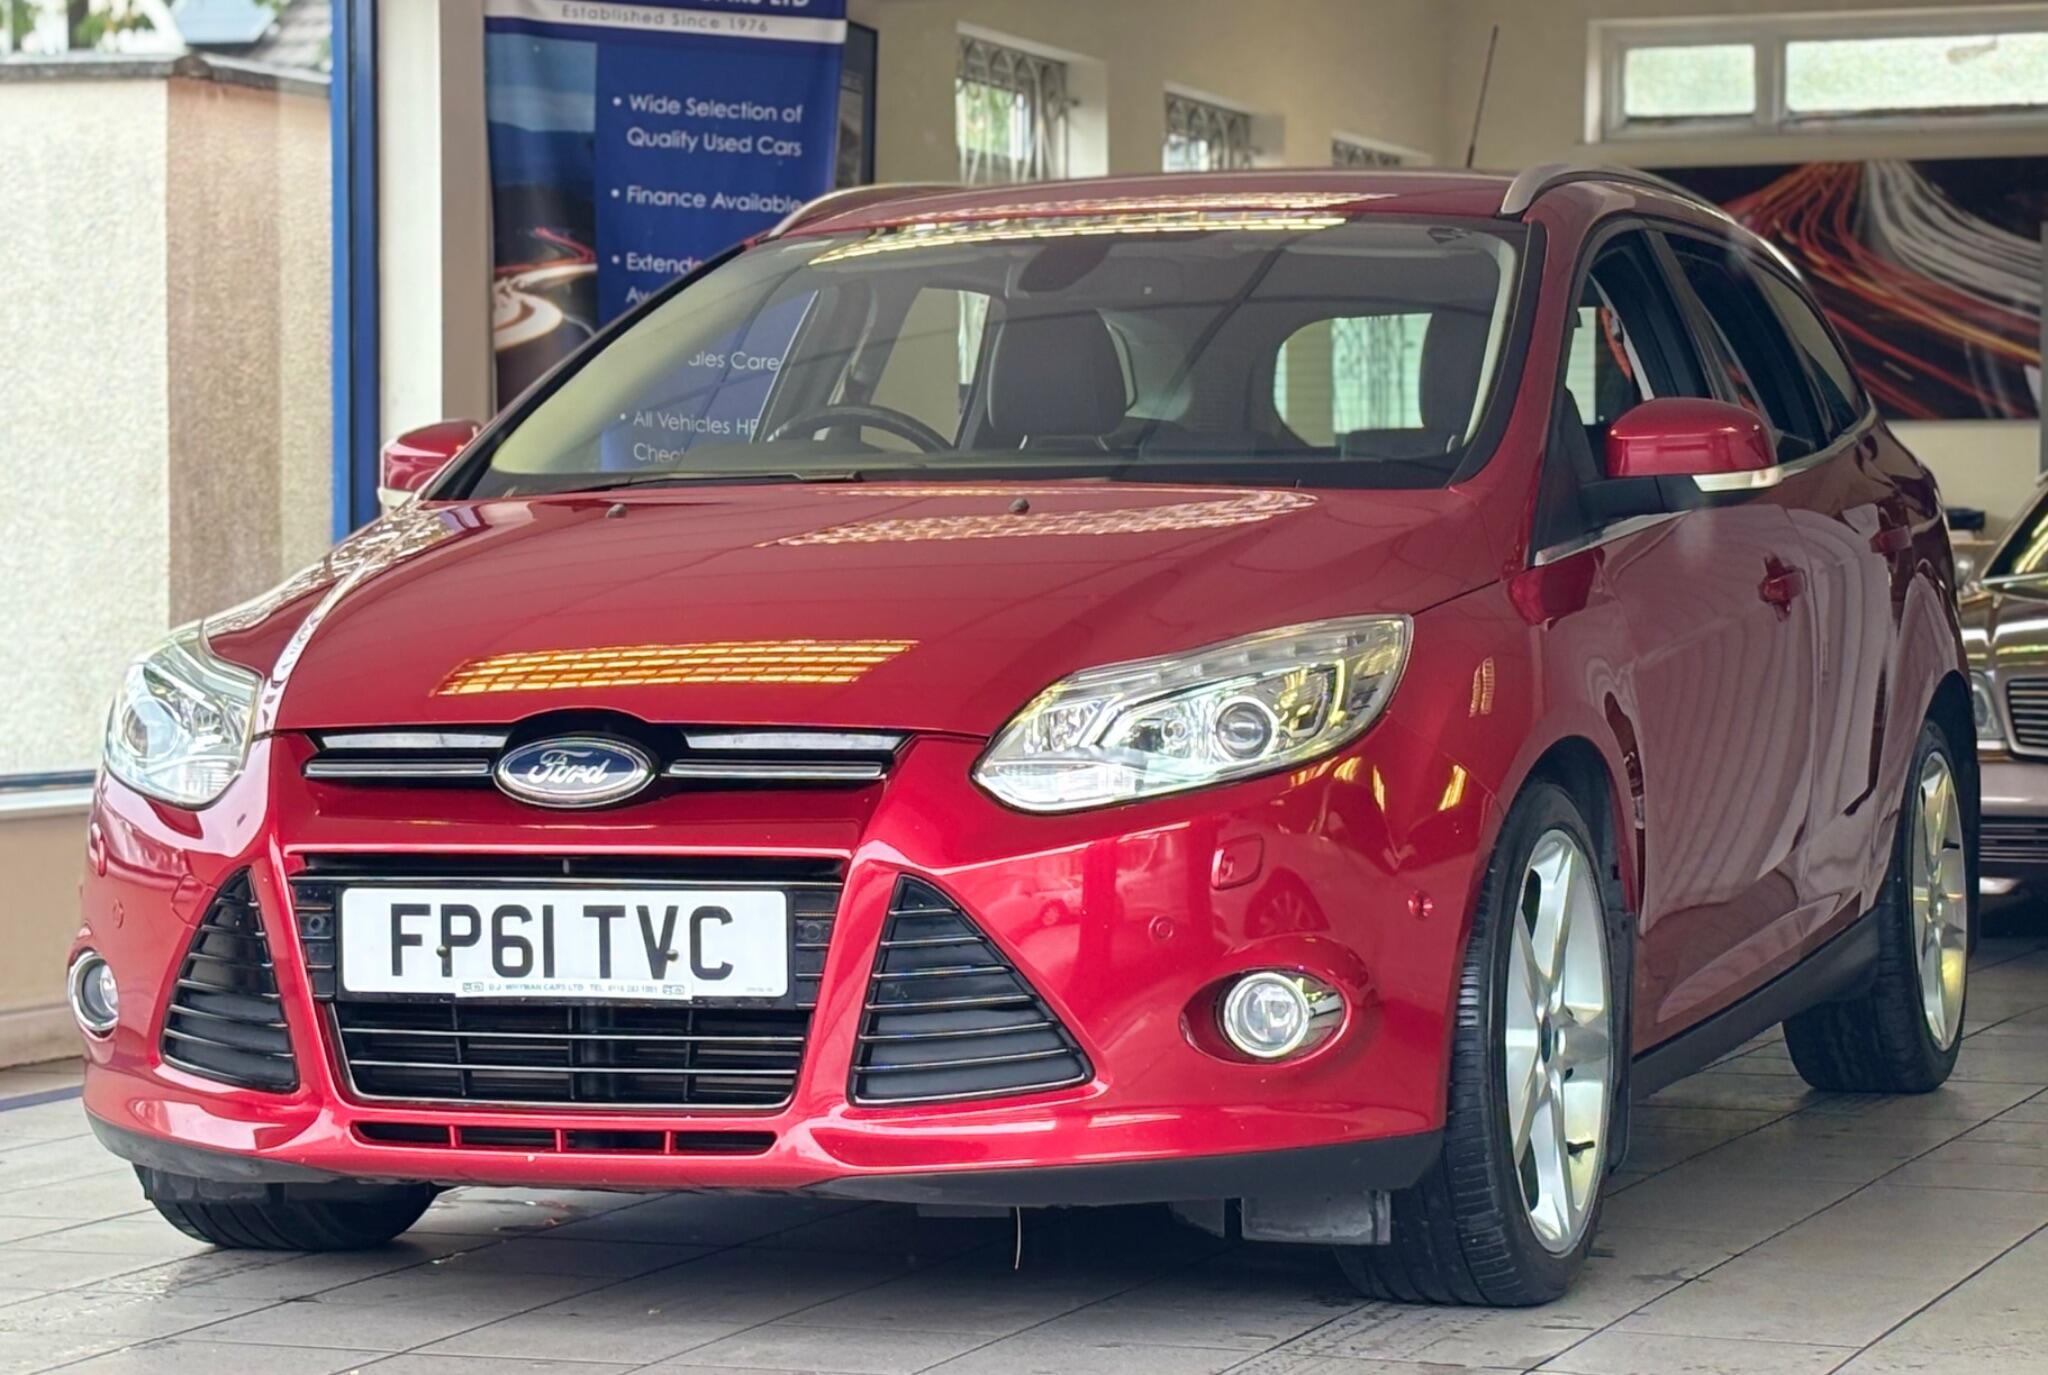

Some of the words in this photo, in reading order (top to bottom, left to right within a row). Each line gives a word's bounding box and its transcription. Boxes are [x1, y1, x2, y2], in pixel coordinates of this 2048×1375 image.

[561, 4, 664, 25] Established
[671, 13, 720, 29] Since
[728, 16, 769, 33] 1976
[629, 94, 681, 115] Wide
[685, 97, 777, 121] Selection
[782, 104, 803, 123] of
[626, 127, 698, 153] Quality
[703, 132, 752, 153] Used
[757, 136, 802, 157] Cars
[626, 185, 707, 208] Finance
[711, 191, 803, 213] Available
[626, 252, 703, 274] Extend
[730, 351, 780, 371] Care
[633, 411, 653, 428] All
[657, 412, 730, 435] Vehicles
[633, 442, 685, 463] Chec
[527, 750, 611, 784] Ford
[390, 903, 555, 978] FP61
[583, 904, 734, 981] TVC
